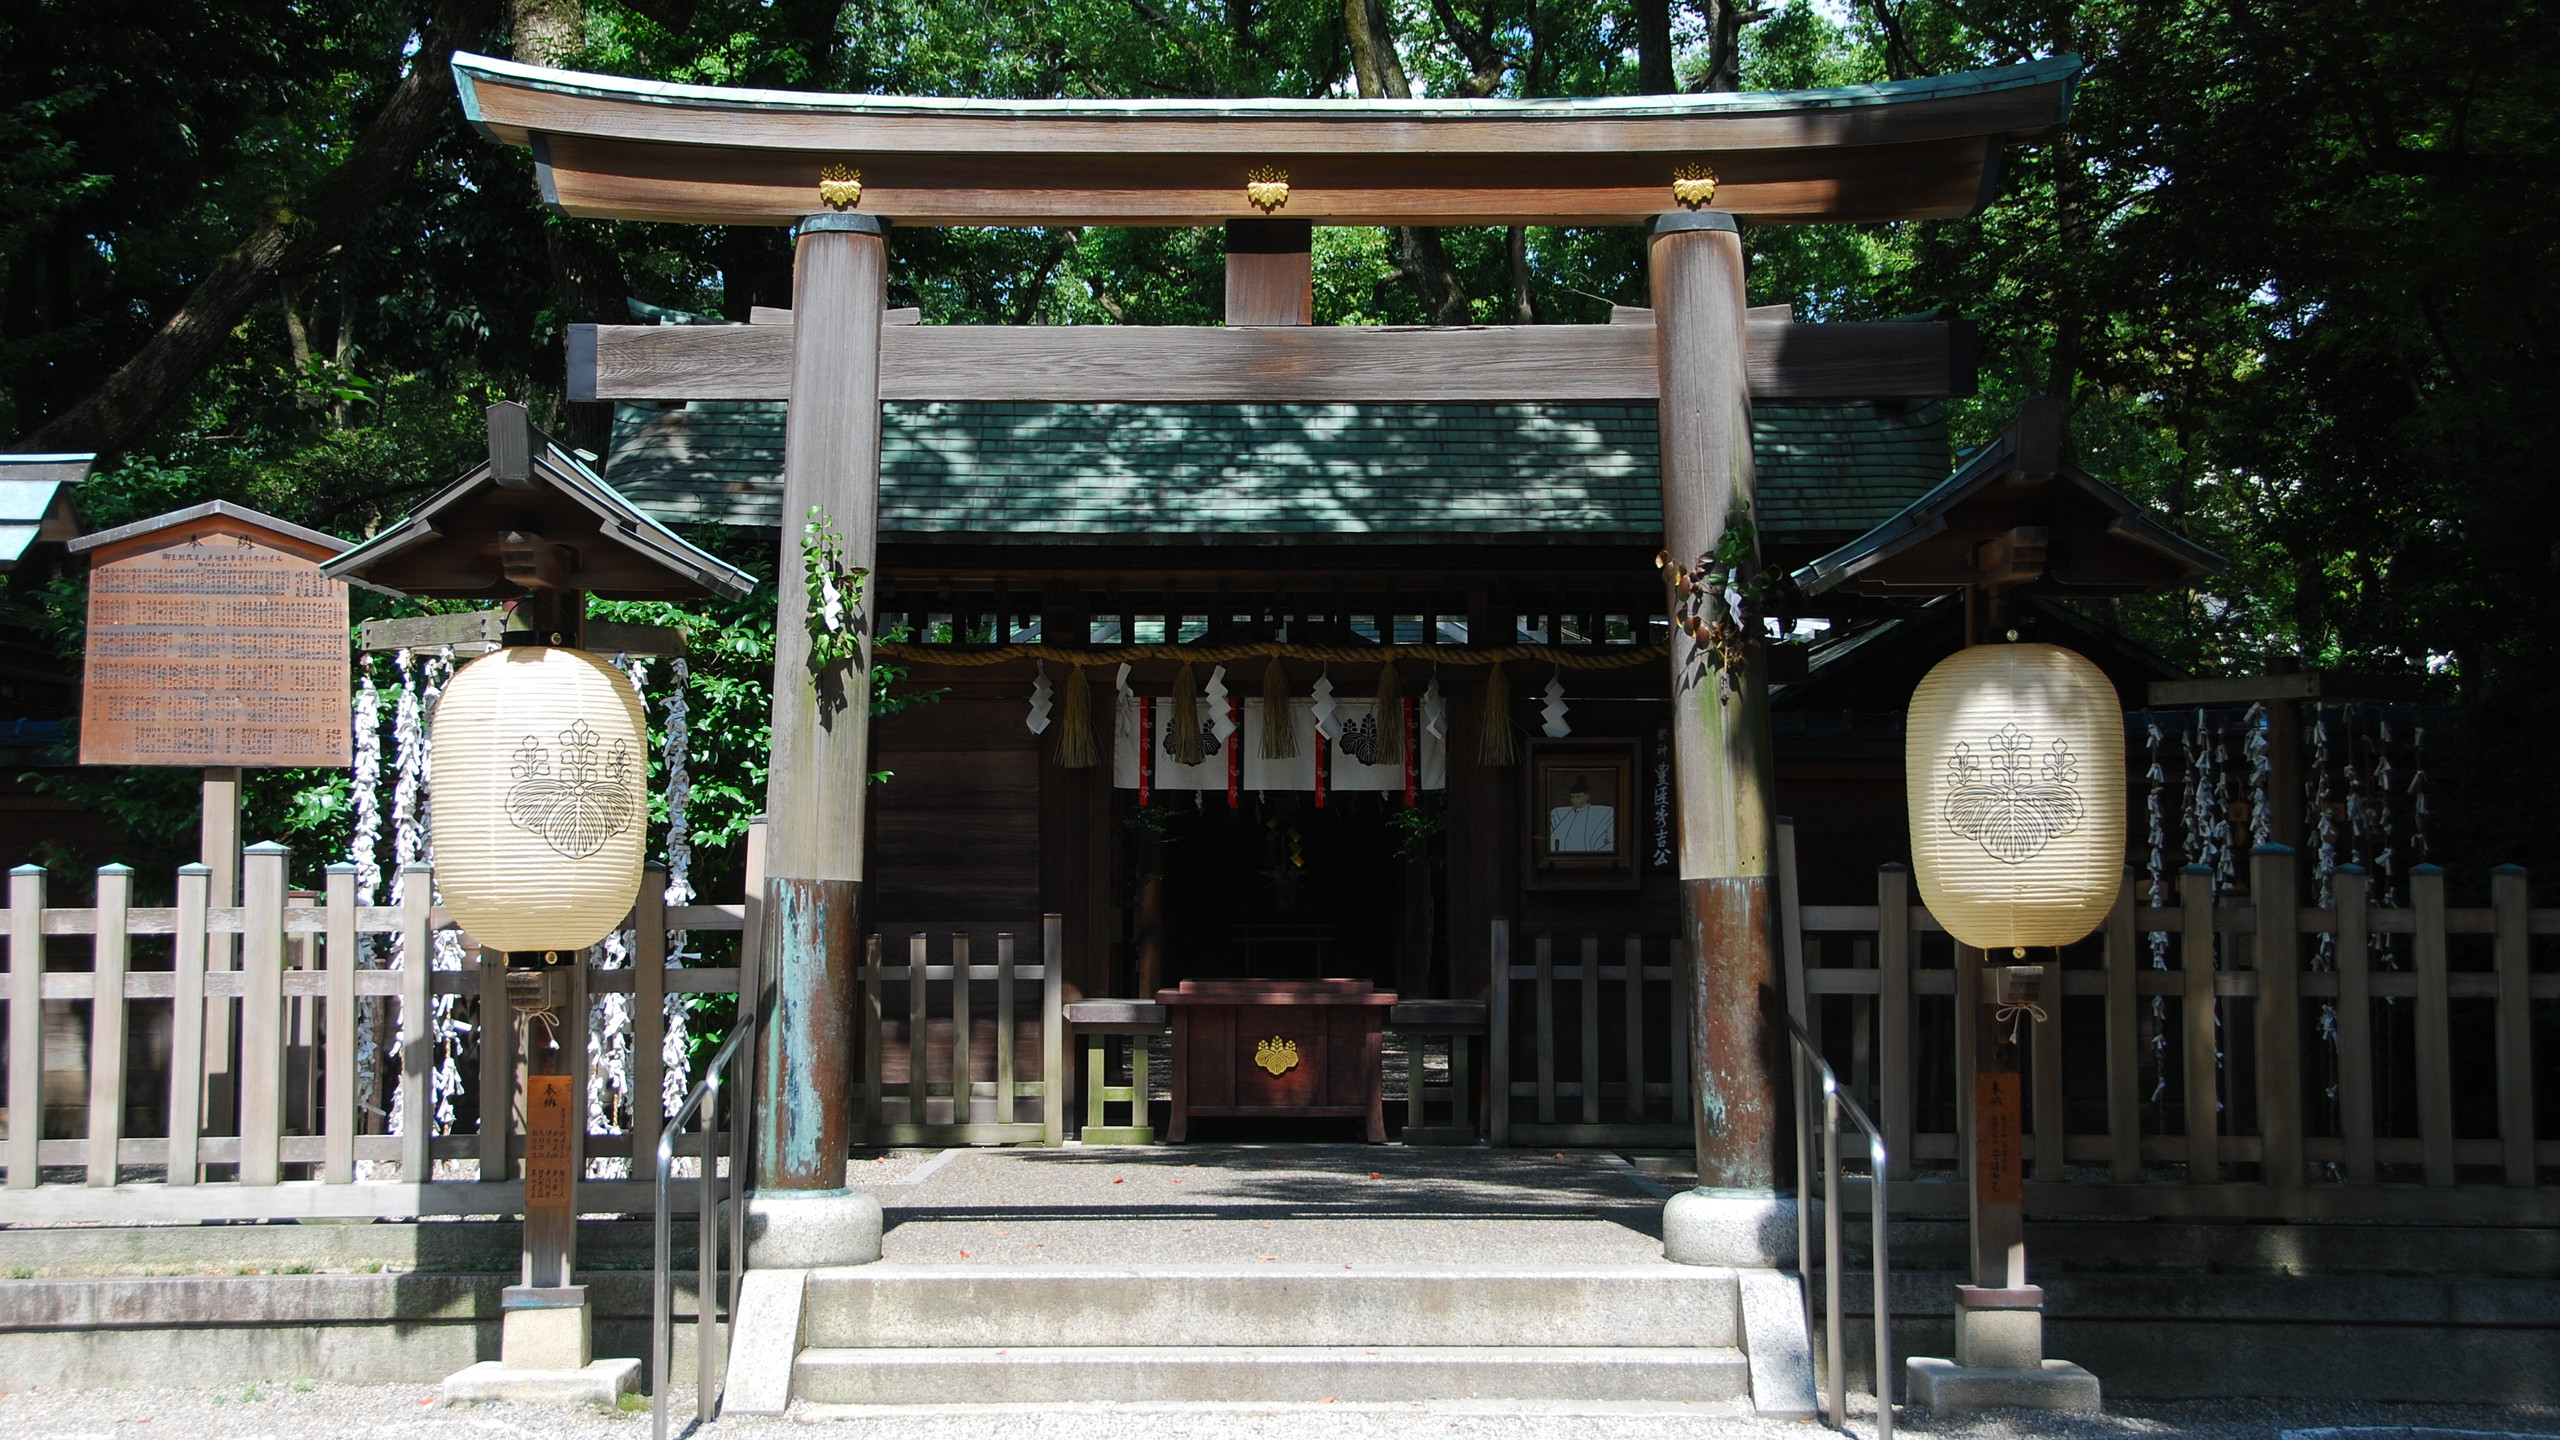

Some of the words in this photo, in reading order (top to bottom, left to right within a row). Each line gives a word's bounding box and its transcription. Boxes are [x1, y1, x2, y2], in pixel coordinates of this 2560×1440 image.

[186, 534, 255, 550] 奉納
[544, 1083, 557, 1107] 奉納
[1991, 1081, 2003, 1105] 奉納
